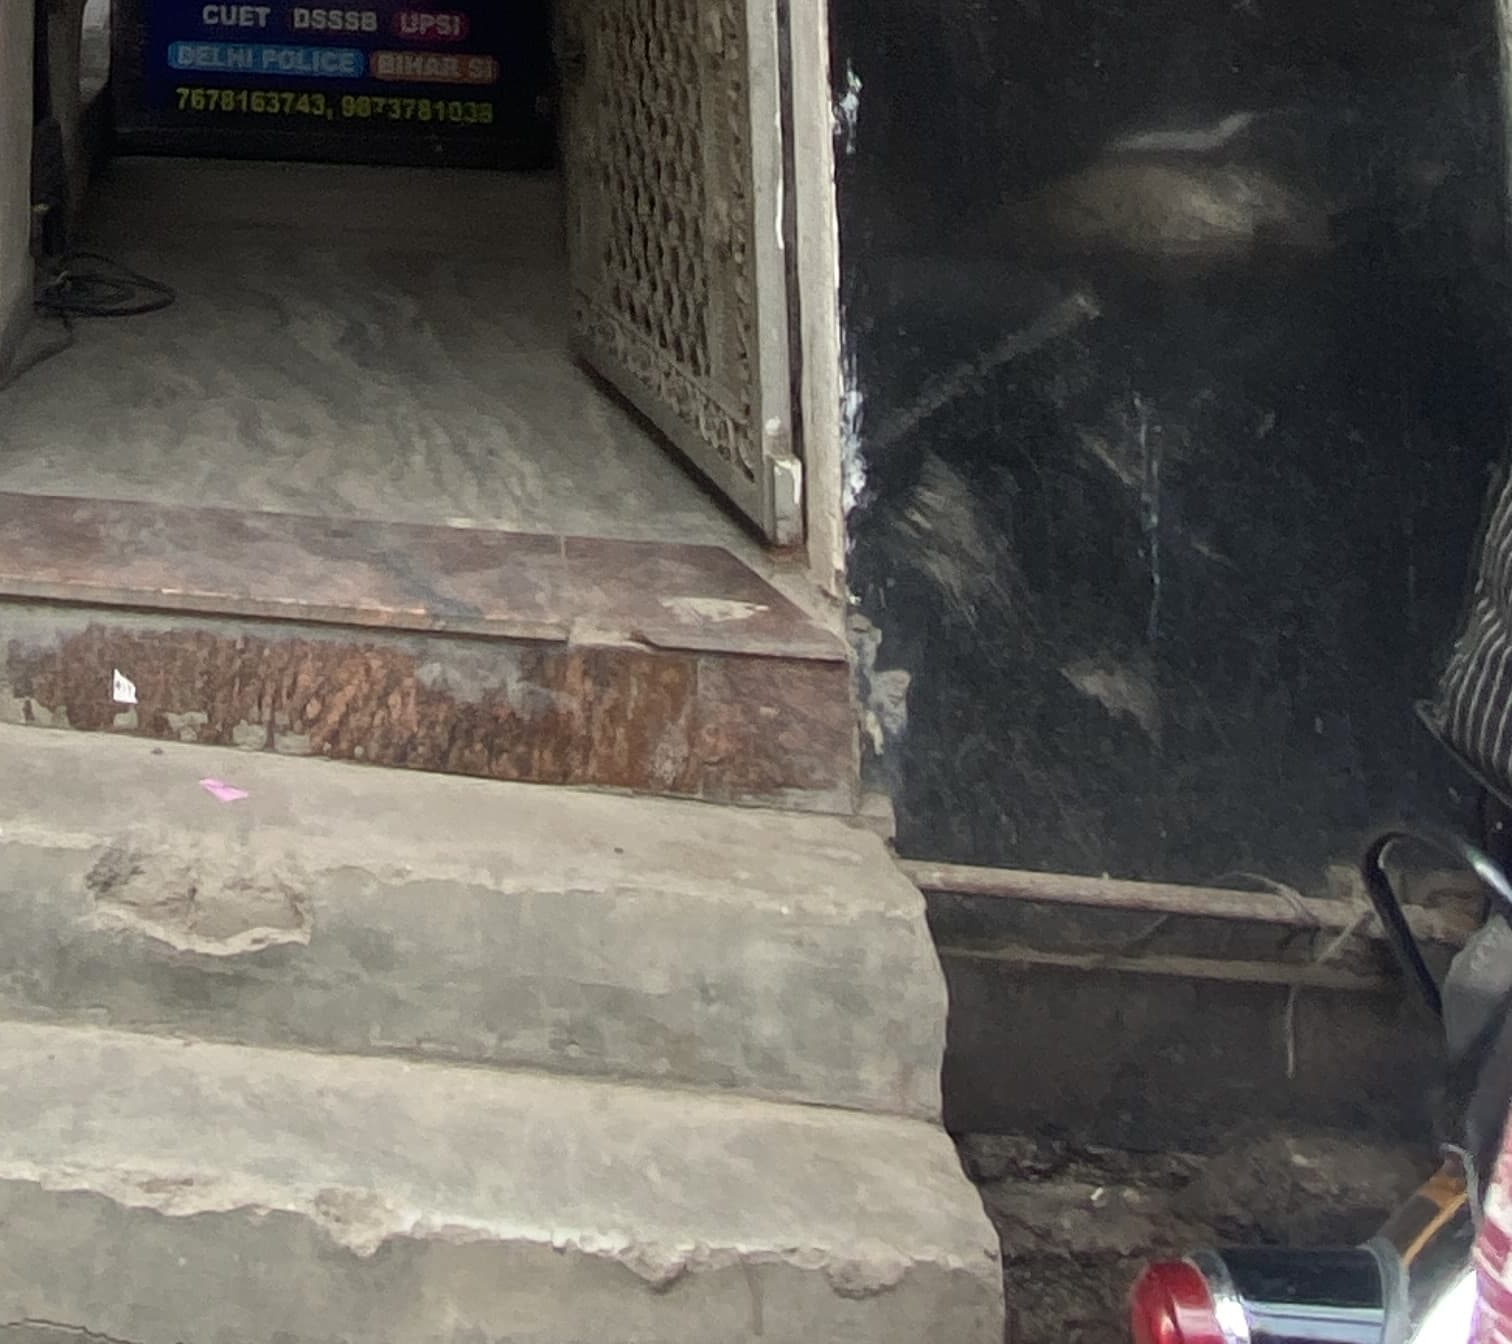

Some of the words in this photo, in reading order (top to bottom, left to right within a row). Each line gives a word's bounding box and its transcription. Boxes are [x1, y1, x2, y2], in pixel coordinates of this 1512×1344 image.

[202, 4, 272, 28] CUET
[293, 7, 378, 32] DSSSB
[178, 43, 254, 68] DELHI
[262, 47, 356, 74] POLICE
[377, 53, 462, 79] BIHAR
